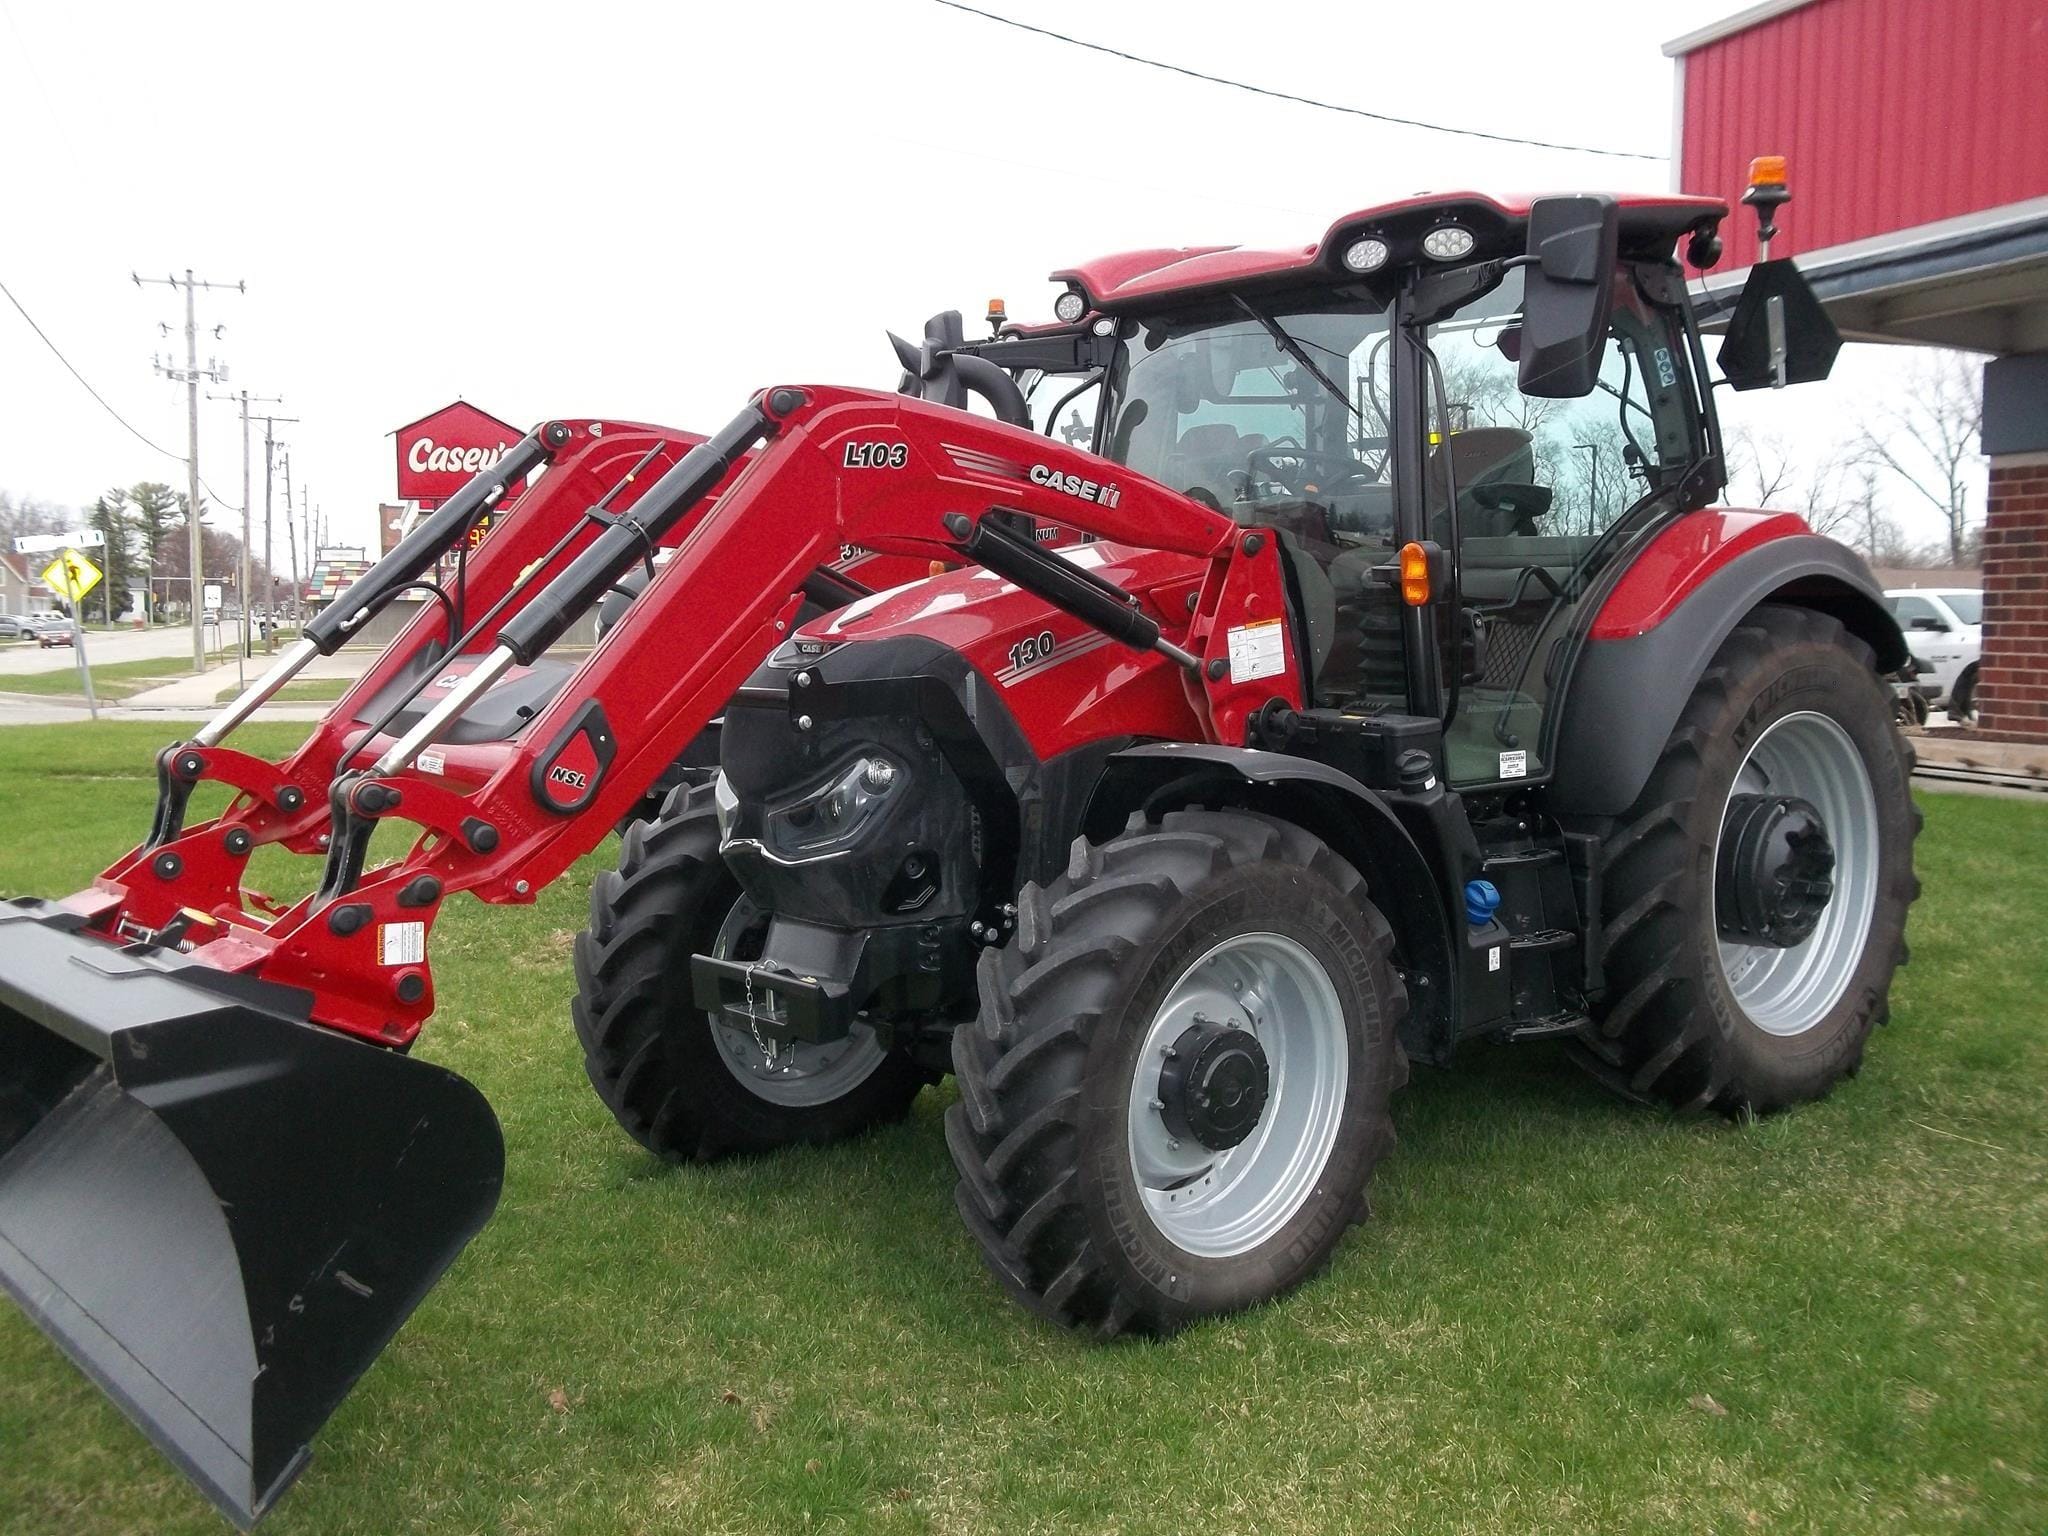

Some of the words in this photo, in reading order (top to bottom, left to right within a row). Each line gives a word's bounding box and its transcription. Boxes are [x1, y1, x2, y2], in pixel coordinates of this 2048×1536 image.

[843, 441, 908, 469] L103
[1029, 464, 1099, 502] CASE
[1035, 526, 1059, 542] NUM
[801, 644, 821, 654] CASE
[1008, 630, 1056, 672] 130
[550, 765, 587, 790] NSL
